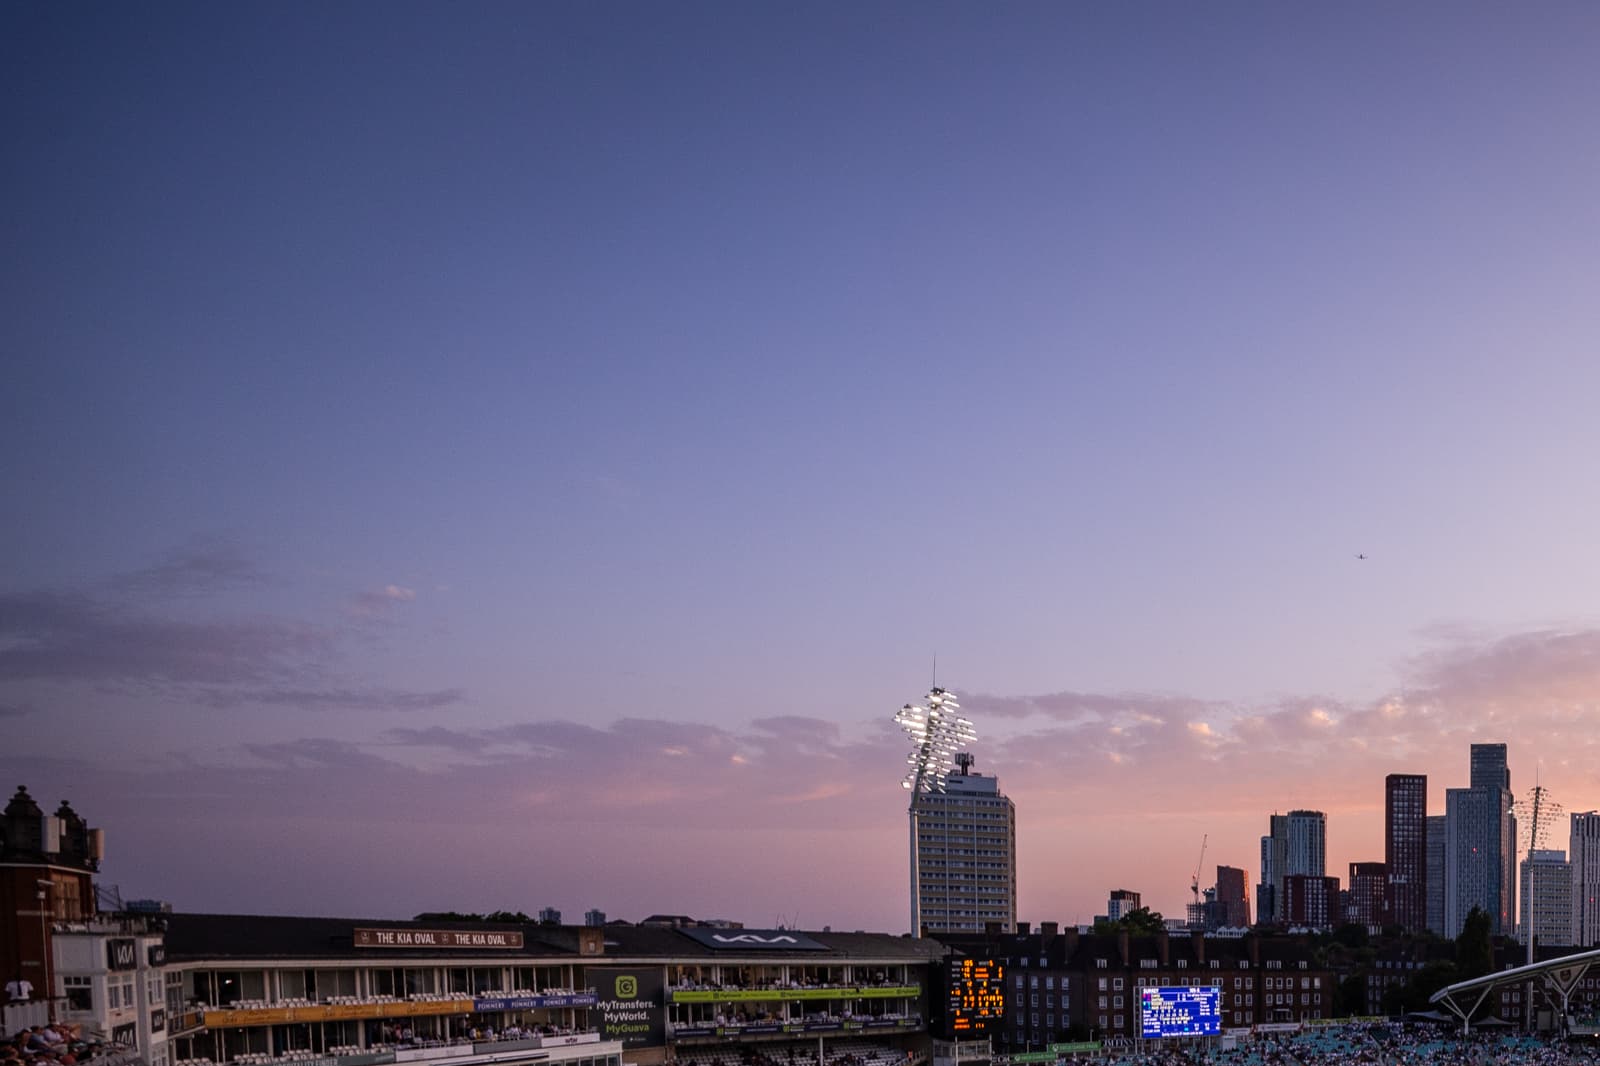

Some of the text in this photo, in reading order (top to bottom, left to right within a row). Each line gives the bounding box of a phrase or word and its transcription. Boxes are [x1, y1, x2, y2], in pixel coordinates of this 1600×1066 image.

[377, 932, 436, 945] THE KIA OVAL
[455, 933, 506, 946] THE KIA OVAL
[596, 1000, 656, 1011] MyTransfers.
[604, 1012, 650, 1023] MyWorld.
[606, 1023, 650, 1033] MyGuava
